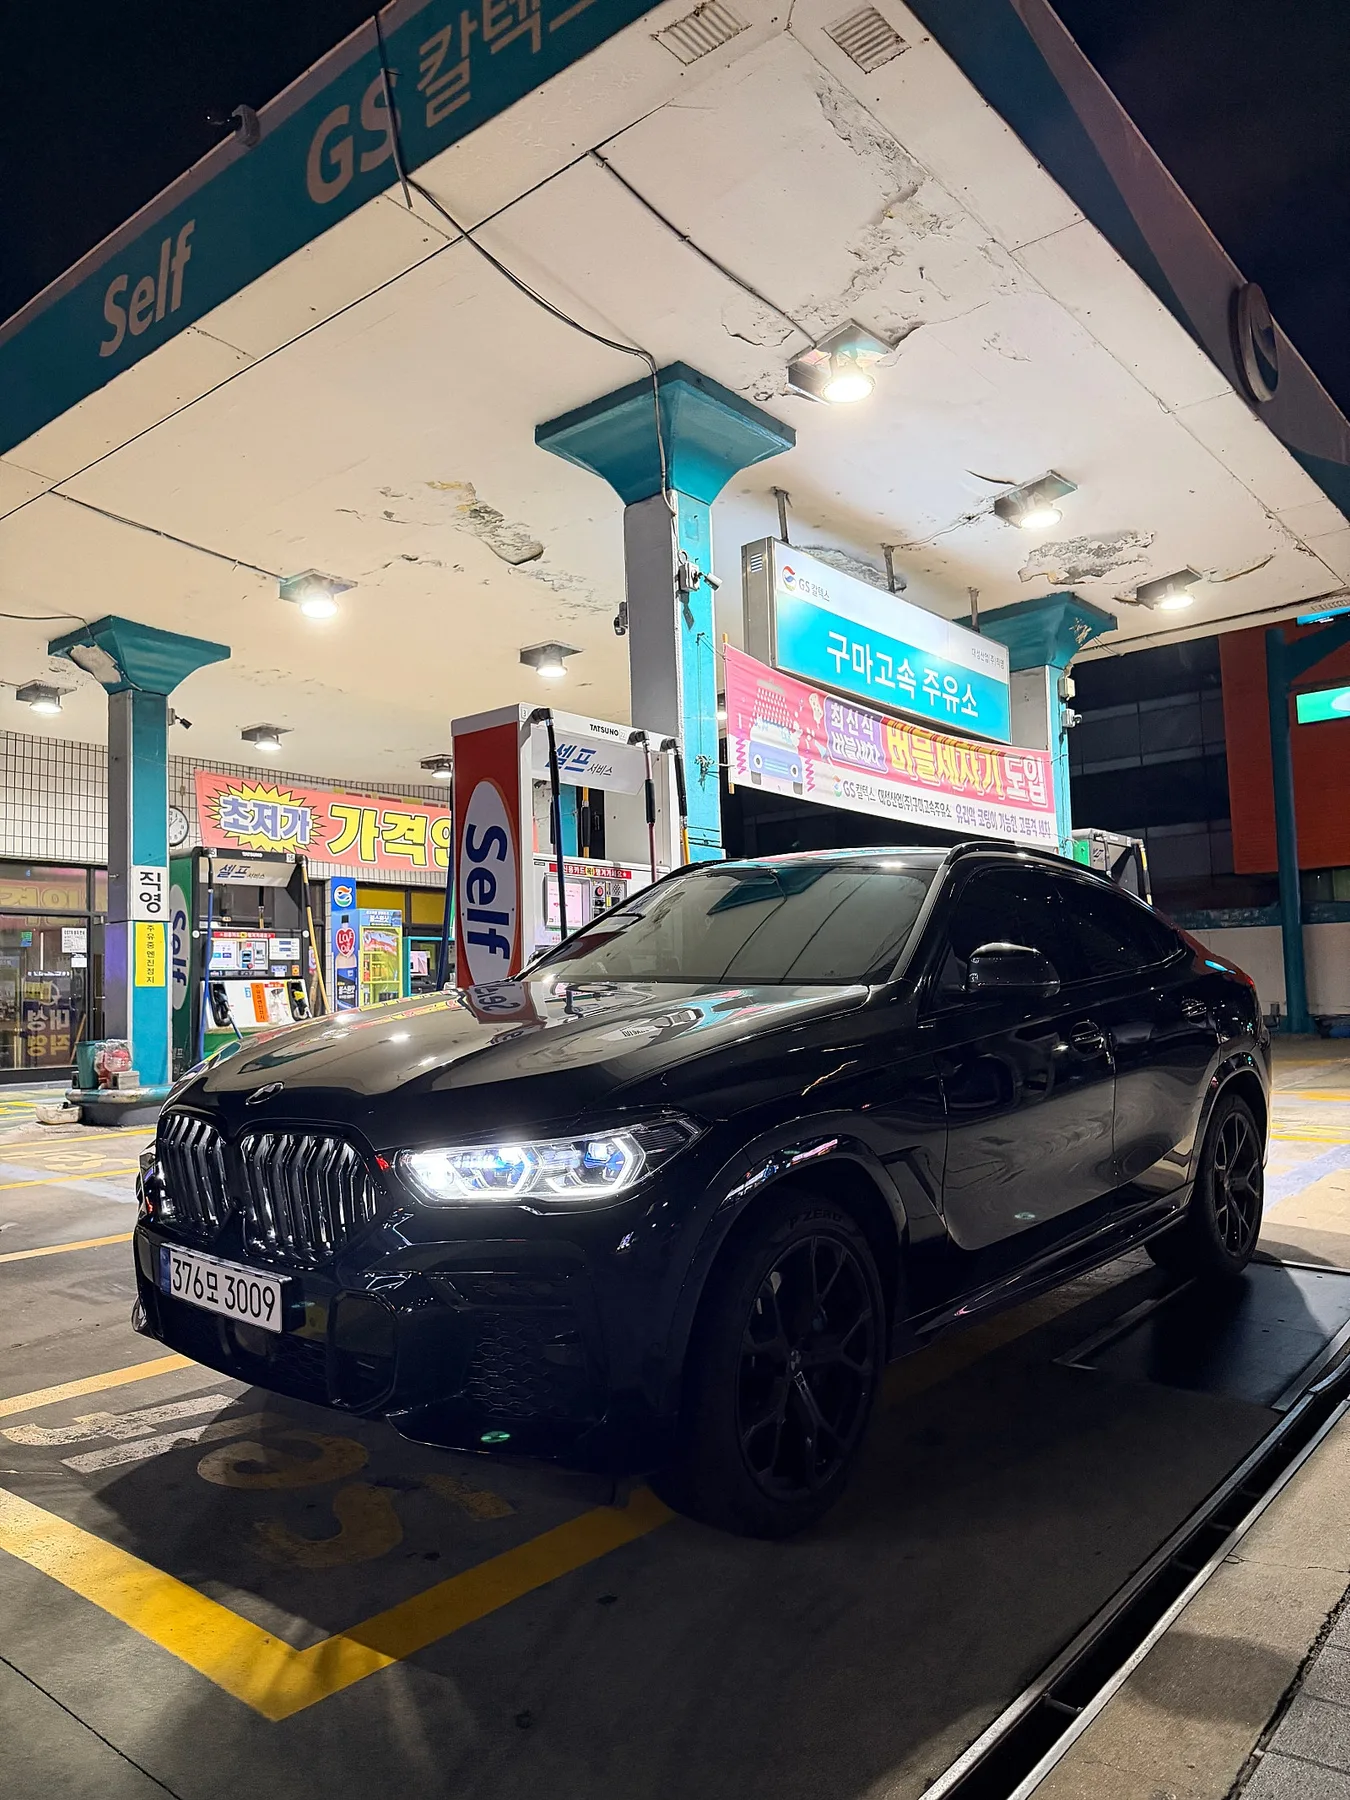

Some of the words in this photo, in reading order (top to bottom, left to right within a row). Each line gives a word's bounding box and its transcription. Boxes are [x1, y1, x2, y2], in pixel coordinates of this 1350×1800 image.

[307, 68, 401, 204] GS
[417, 0, 597, 128] 칼텍
[99, 219, 196, 358] Self
[798, 578, 810, 593] GS
[826, 631, 916, 698] 구마고속
[923, 667, 979, 718] 주유소
[589, 724, 619, 737] TATSUNO
[587, 763, 613, 776] 서비스
[843, 780, 856, 798] GS
[1004, 754, 1047, 805] 도입
[221, 797, 310, 842] 초저가
[140, 871, 161, 914] 직영
[217, 863, 251, 878] 셀프
[465, 823, 511, 960] Self
[172, 1258, 219, 1304] 376모
[224, 1275, 276, 1322] 3009
